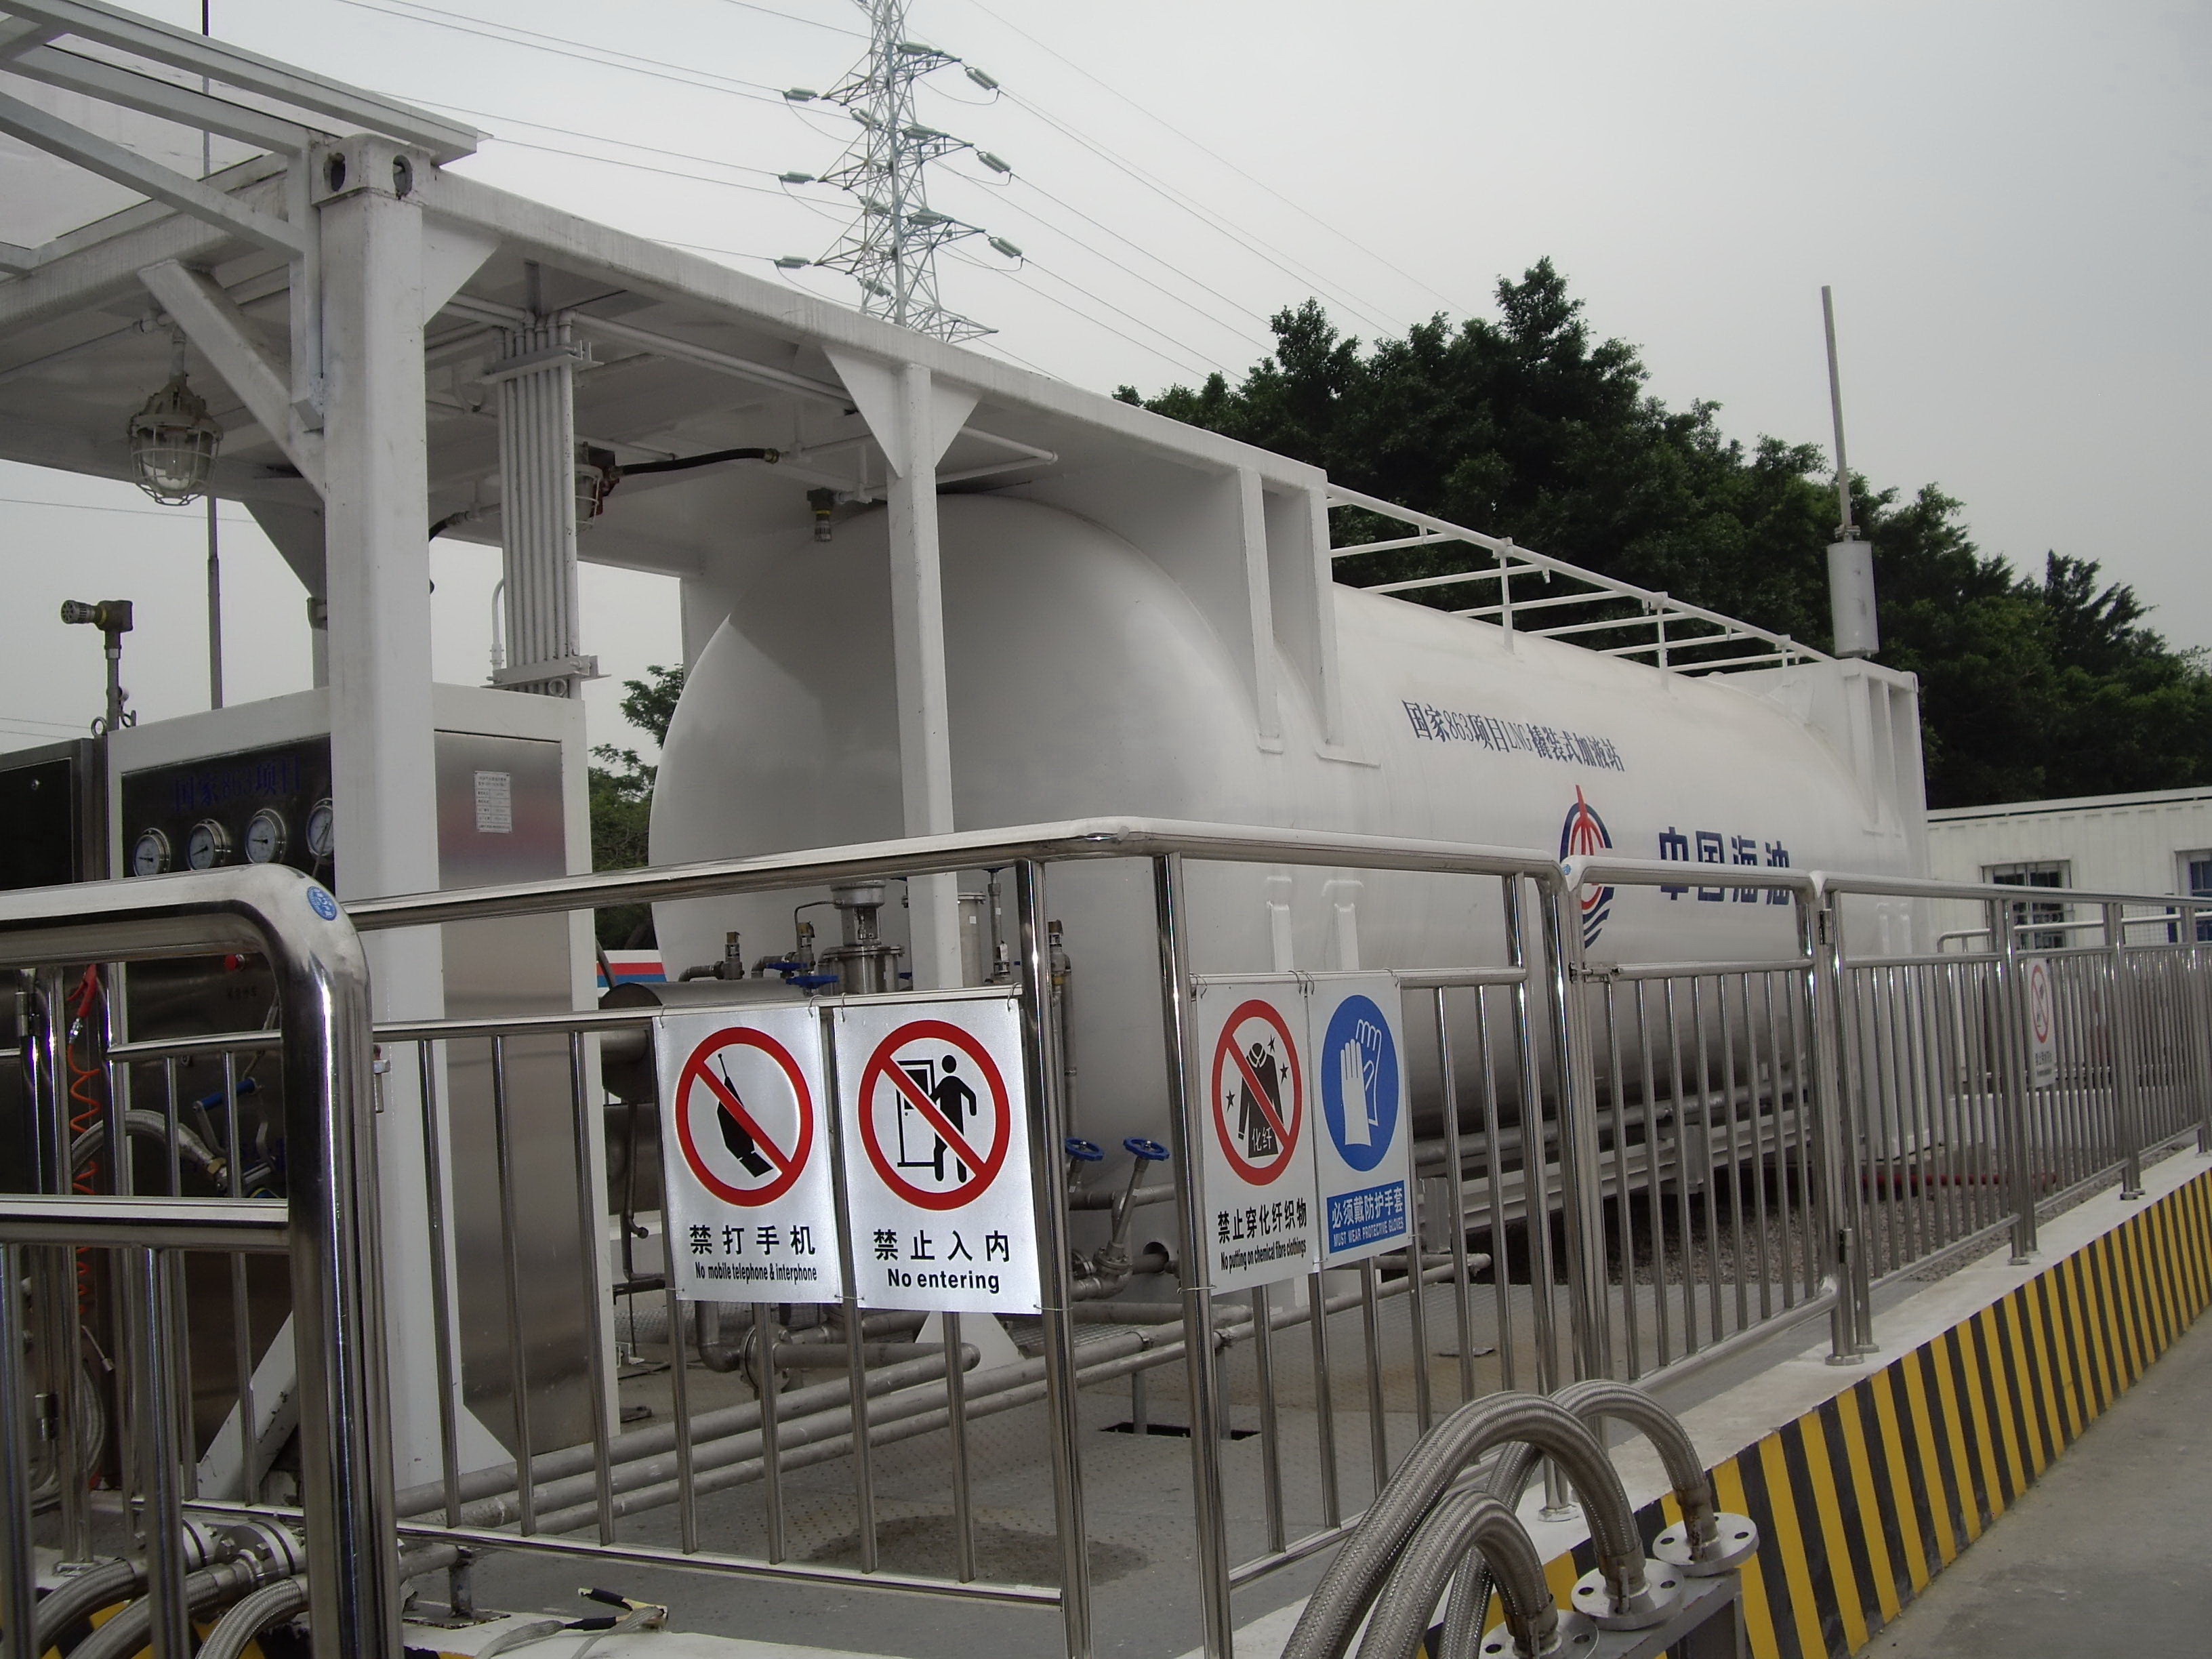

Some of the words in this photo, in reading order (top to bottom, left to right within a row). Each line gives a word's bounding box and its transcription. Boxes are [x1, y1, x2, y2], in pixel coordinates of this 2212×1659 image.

[1659, 826, 1790, 905] 中国海油
[1252, 1127, 1272, 1151] 化纤
[1218, 1197, 1307, 1244] 禁止穿化纤织物
[1332, 1186, 1403, 1229] 必须戴防护手套
[689, 1225, 816, 1255] 禁打手机
[873, 1229, 1010, 1263] 禁止入内
[1333, 1231, 1347, 1247] MUST
[1347, 1228, 1361, 1243] WEAR
[1362, 1221, 1388, 1240] PROTECTIVE
[1389, 1216, 1404, 1232] GLOVES
[1221, 1252, 1229, 1271] No
[1229, 1248, 1247, 1274] putting
[1248, 1250, 1254, 1265] on
[1254, 1242, 1275, 1264] chemical
[1275, 1240, 1286, 1258] fibre
[1286, 1236, 1307, 1258] clothings
[695, 1261, 705, 1279] No
[708, 1262, 731, 1279] mobile
[732, 1263, 768, 1284] telephone
[769, 1263, 775, 1280] &
[776, 1263, 817, 1285] interphone
[887, 1268, 912, 1287] No
[917, 1270, 1000, 1294] entering
